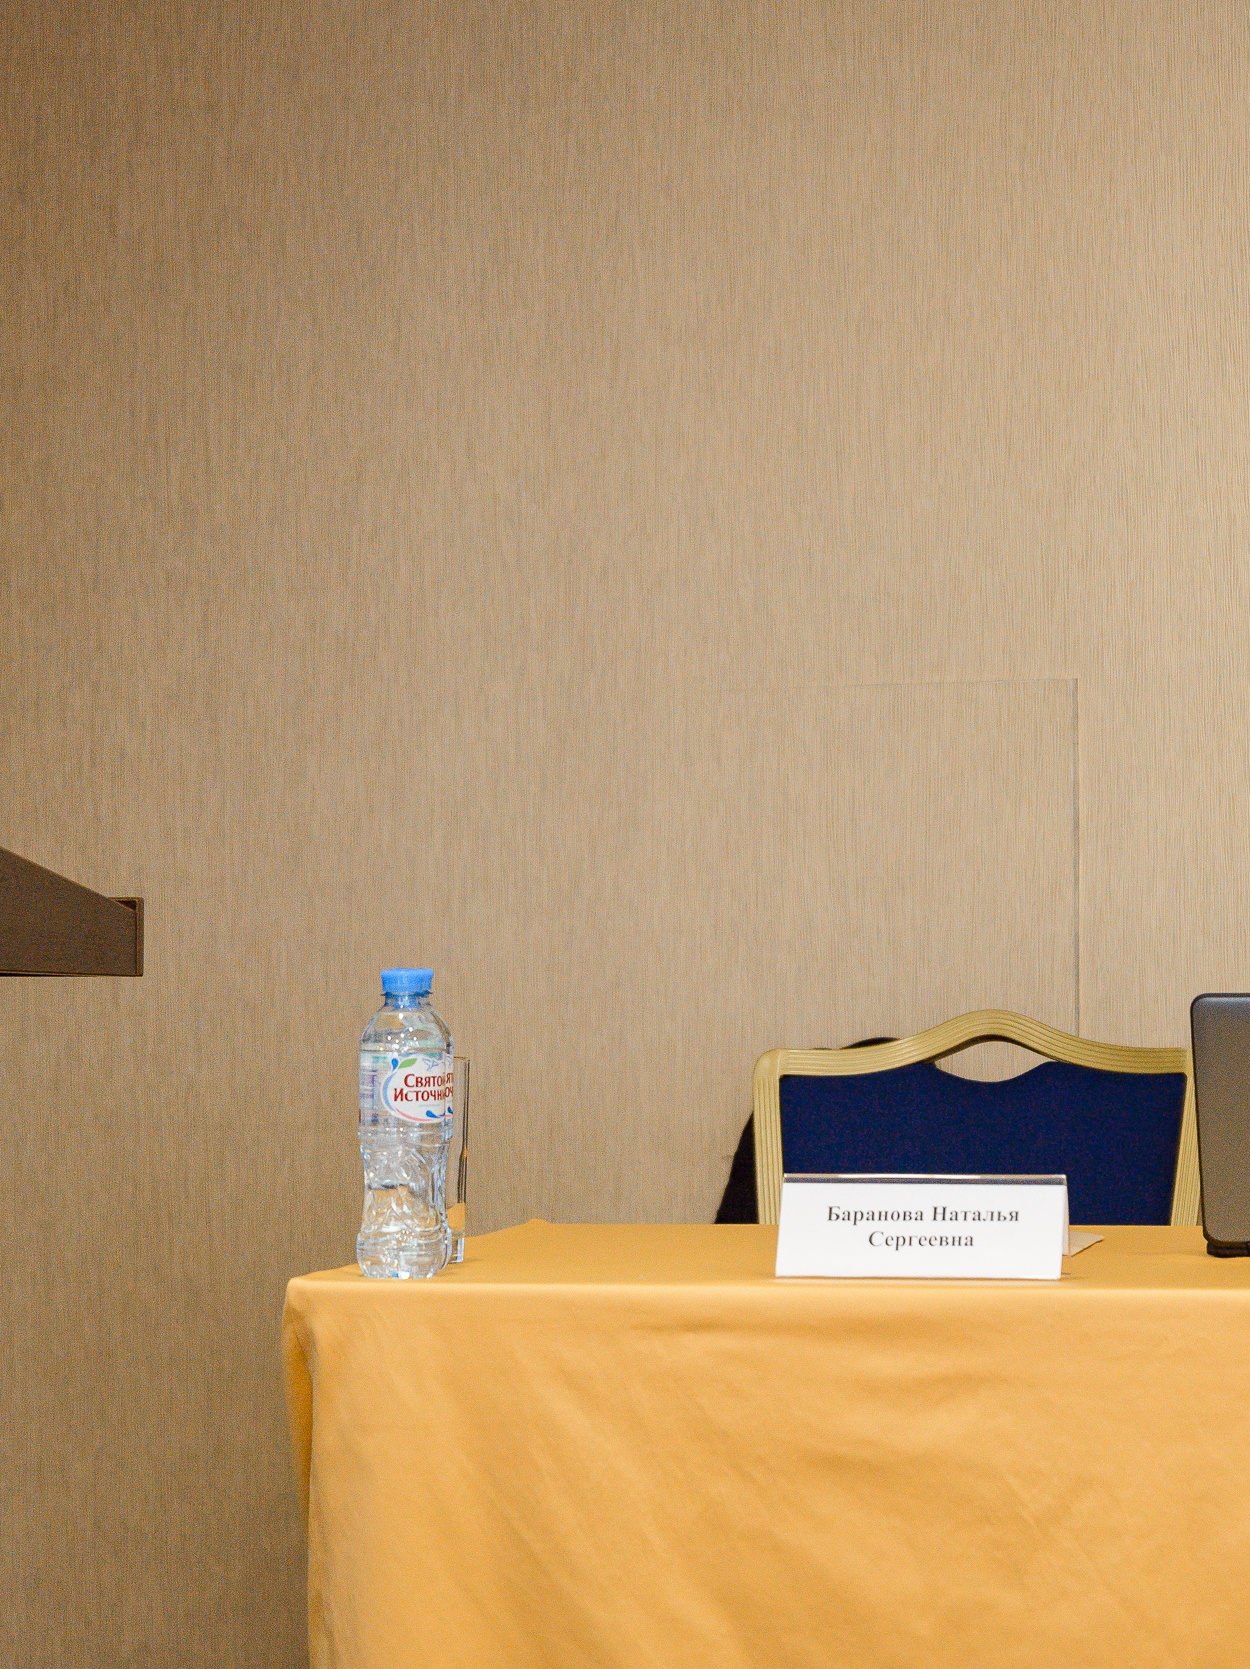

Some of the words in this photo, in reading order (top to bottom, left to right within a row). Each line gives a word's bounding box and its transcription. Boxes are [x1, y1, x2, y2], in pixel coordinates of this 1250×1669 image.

[827, 1205, 924, 1226] Баранова
[932, 1205, 1020, 1222] Наталья
[868, 1230, 974, 1251] Сергеевна
